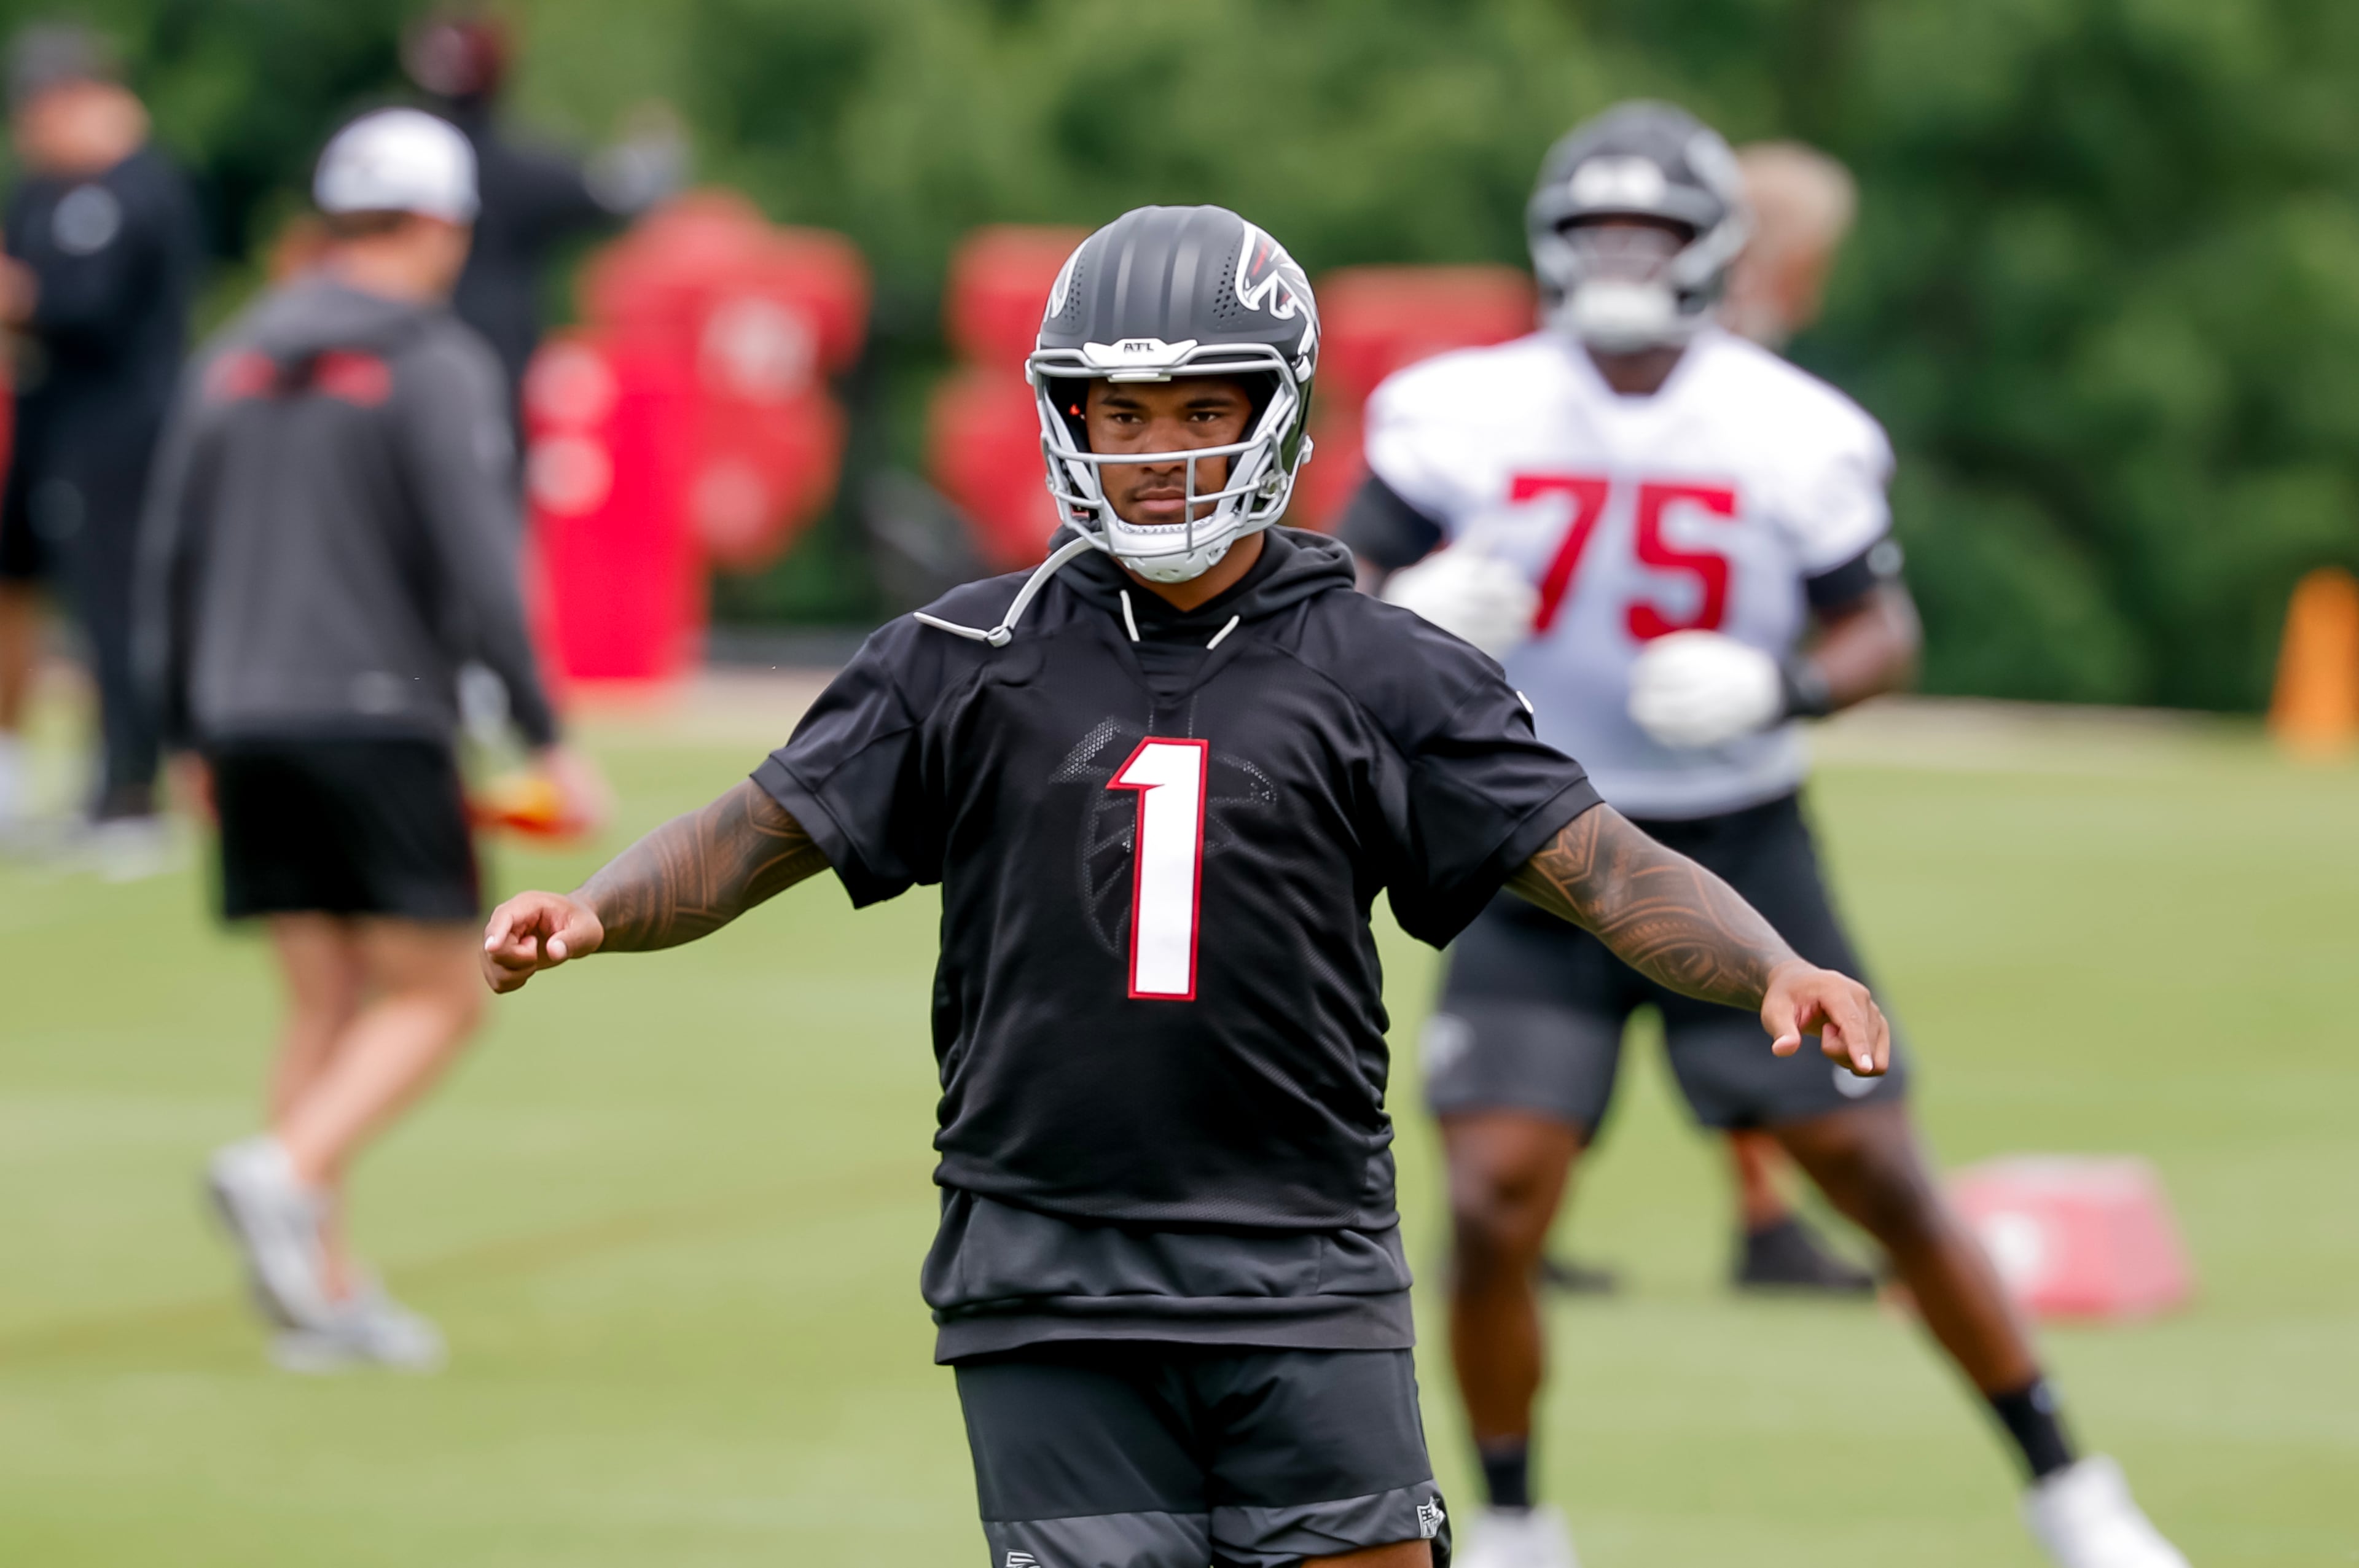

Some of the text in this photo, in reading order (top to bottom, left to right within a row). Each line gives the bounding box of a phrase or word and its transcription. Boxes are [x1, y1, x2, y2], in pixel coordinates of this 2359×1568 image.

[1124, 343, 1154, 353] ATL
[1509, 475, 1736, 640] 75
[1105, 736, 1208, 1001] 1
